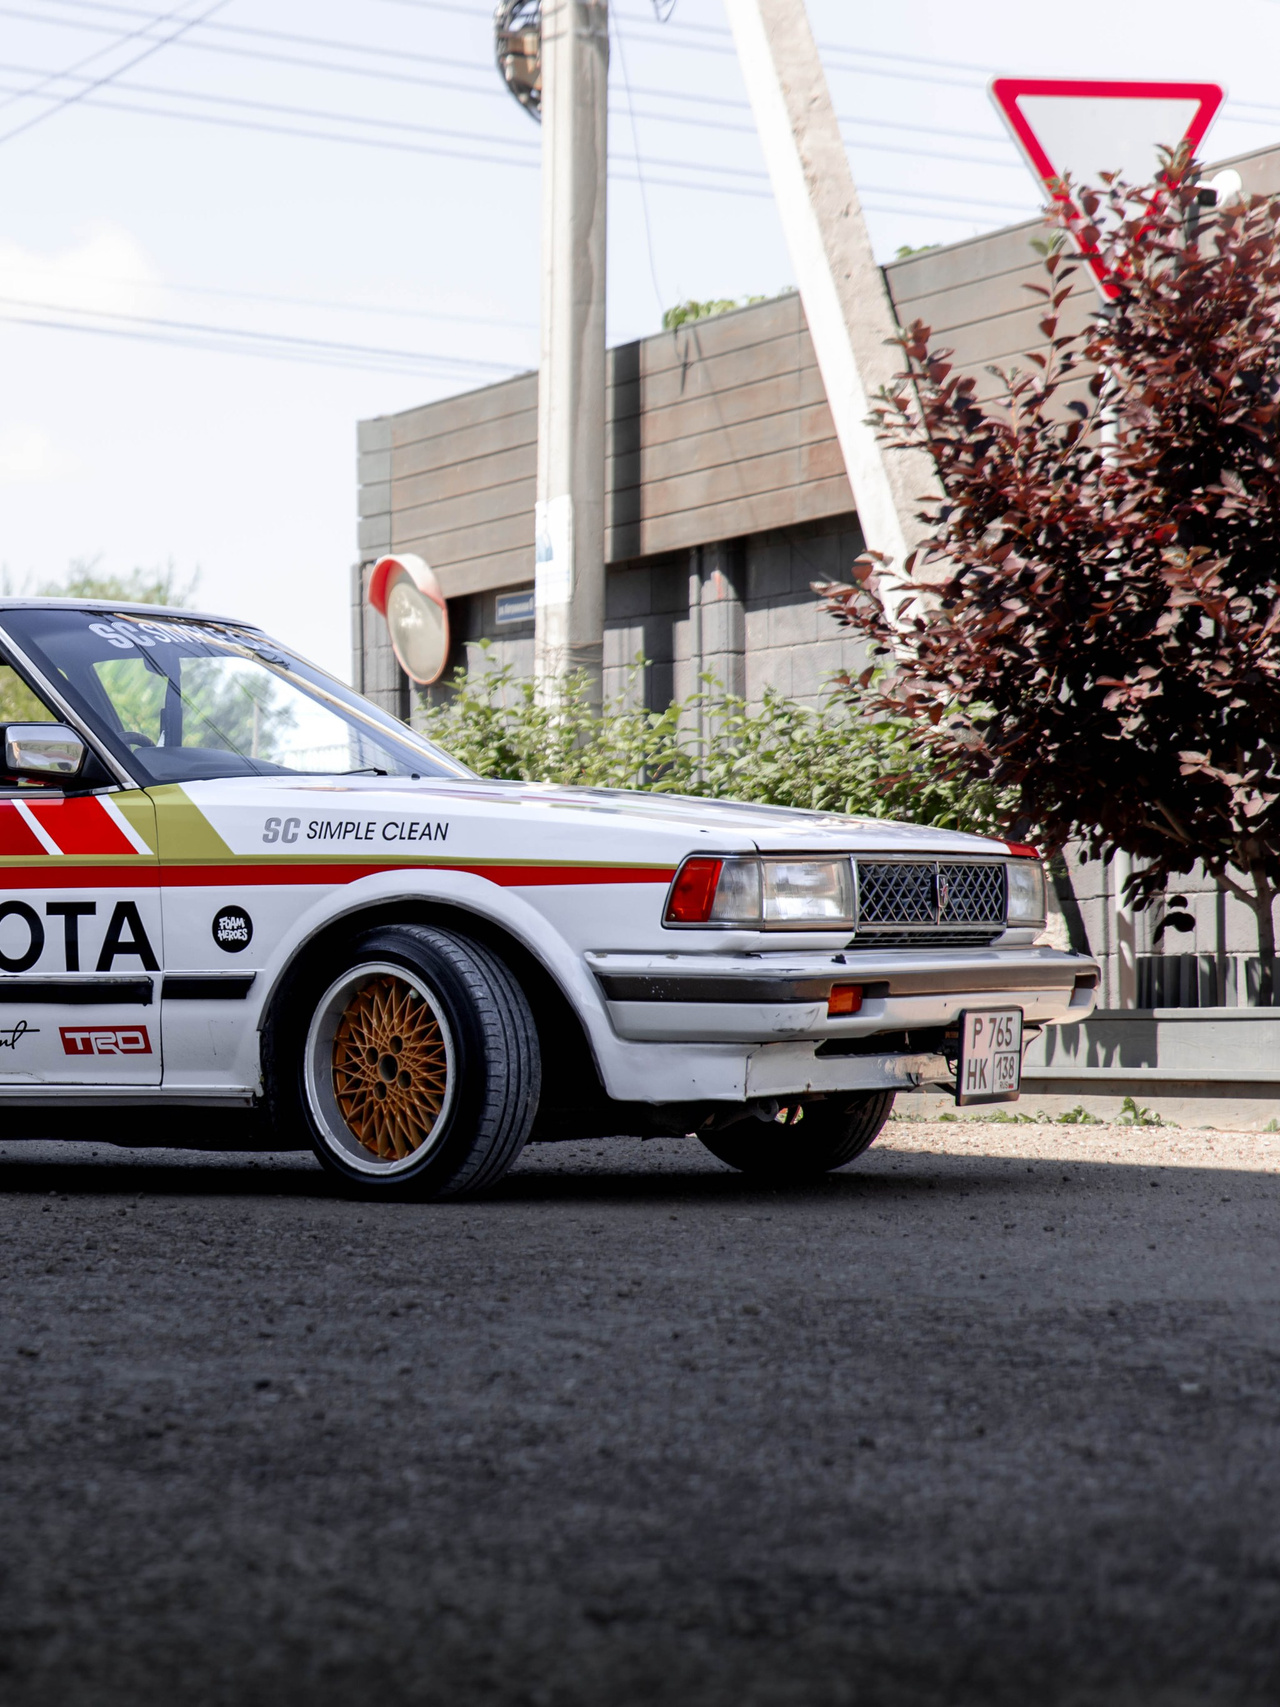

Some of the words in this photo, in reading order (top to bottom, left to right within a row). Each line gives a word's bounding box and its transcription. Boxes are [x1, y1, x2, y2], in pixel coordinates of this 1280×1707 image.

[88, 621, 156, 649] SC
[262, 817, 301, 844] SC
[307, 820, 376, 841] SIMPLE
[381, 821, 449, 841] CLEAN
[217, 929, 248, 941] HEROES
[219, 916, 245, 930] FOAM
[64, 1030, 146, 1056] TRD
[988, 1016, 1013, 1049] 765
[996, 1056, 1015, 1080] 138
